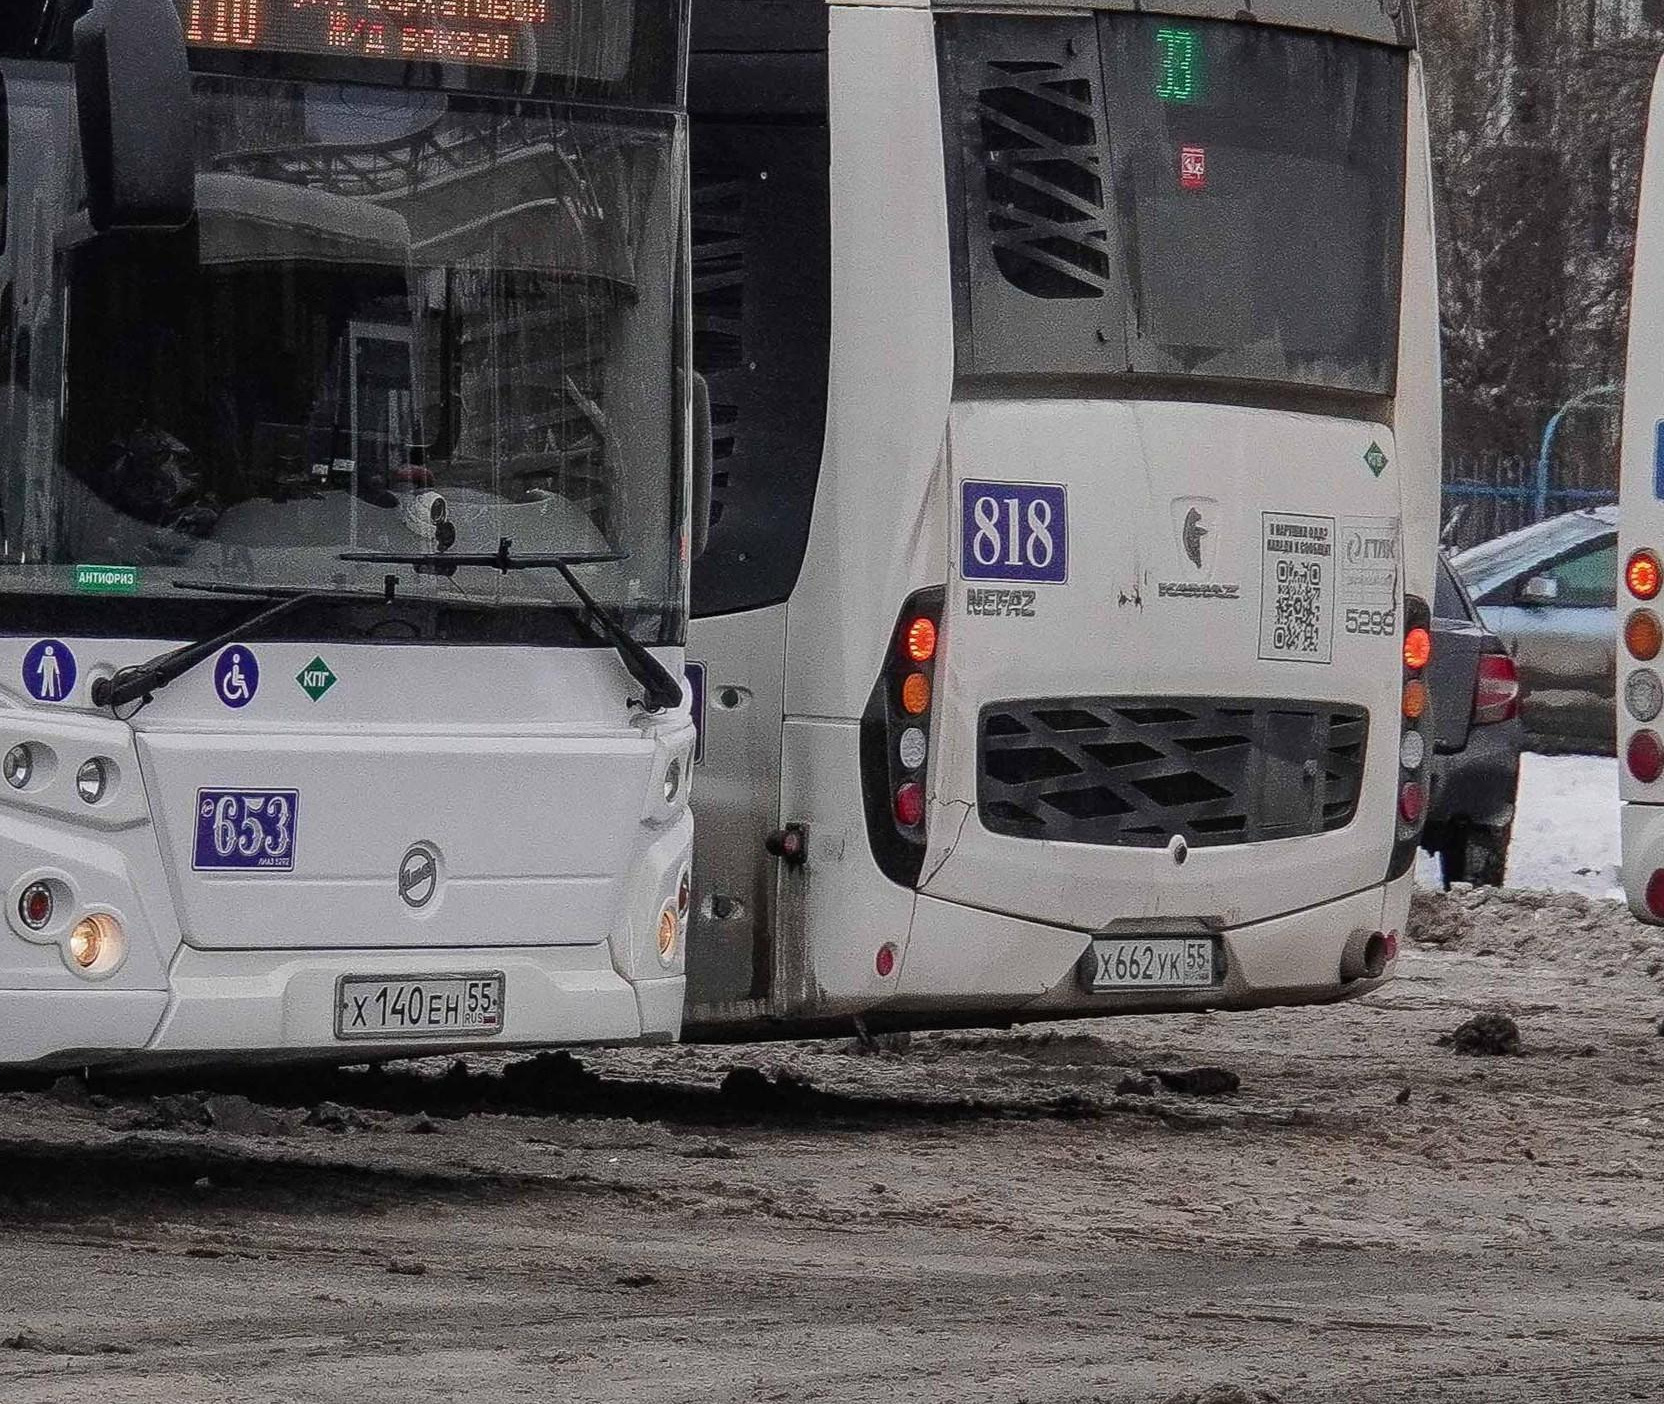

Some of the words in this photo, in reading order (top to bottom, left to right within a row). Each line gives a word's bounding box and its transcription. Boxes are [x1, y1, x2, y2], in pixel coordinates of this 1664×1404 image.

[972, 495, 1054, 569] 818
[78, 571, 134, 585] АНТИФРИЗ
[966, 587, 1036, 617] NEFAZ
[303, 670, 329, 688] КПГ
[213, 795, 290, 857] 653
[467, 982, 492, 1013] 55
[464, 1012, 483, 1025] RUS
